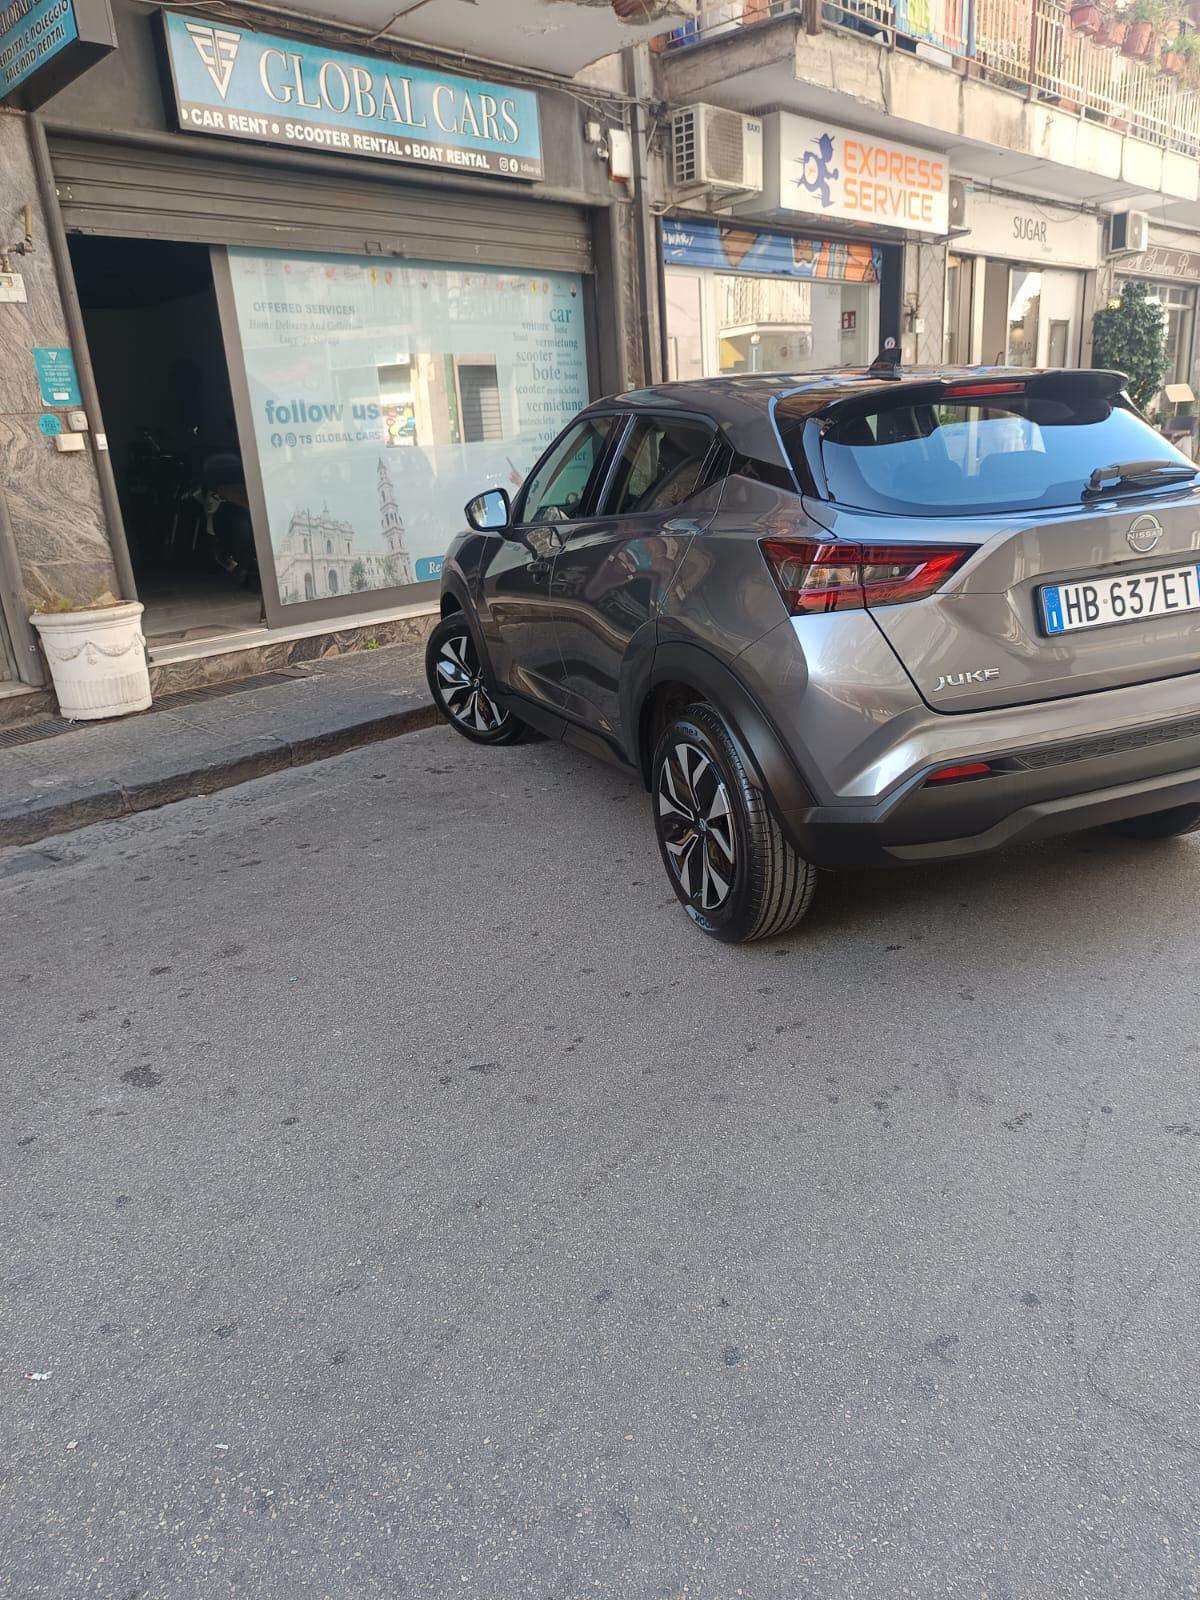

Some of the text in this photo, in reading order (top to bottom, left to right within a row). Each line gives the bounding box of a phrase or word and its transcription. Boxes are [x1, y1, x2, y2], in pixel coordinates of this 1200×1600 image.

[0, 0, 31, 36] LOBAL
[0, 38, 25, 68] ENDITA
[30, 0, 69, 41] NOLEGGIO
[5, 24, 65, 84] SALE AND RENTAL
[259, 46, 520, 145] GLOBAL CARS
[191, 107, 491, 170] CAR RENT SCOOTER RENTAL BOAT RENTAL
[843, 139, 944, 193] EXPRESS
[843, 179, 934, 223] SERVICE
[1013, 216, 1048, 243] SUGAR
[253, 301, 356, 318] OFFERED SERVICES
[549, 308, 572, 324] car
[515, 350, 553, 362] scooter
[532, 362, 562, 382] bote
[264, 399, 381, 425] follow us
[526, 398, 584, 413] vermietung
[298, 431, 384, 446] TS GLOBAL CARS
[1126, 527, 1163, 541] NISSAN
[429, 561, 442, 574] Re
[1064, 570, 1193, 625] HB 637ET
[932, 667, 1001, 692] JUKE
